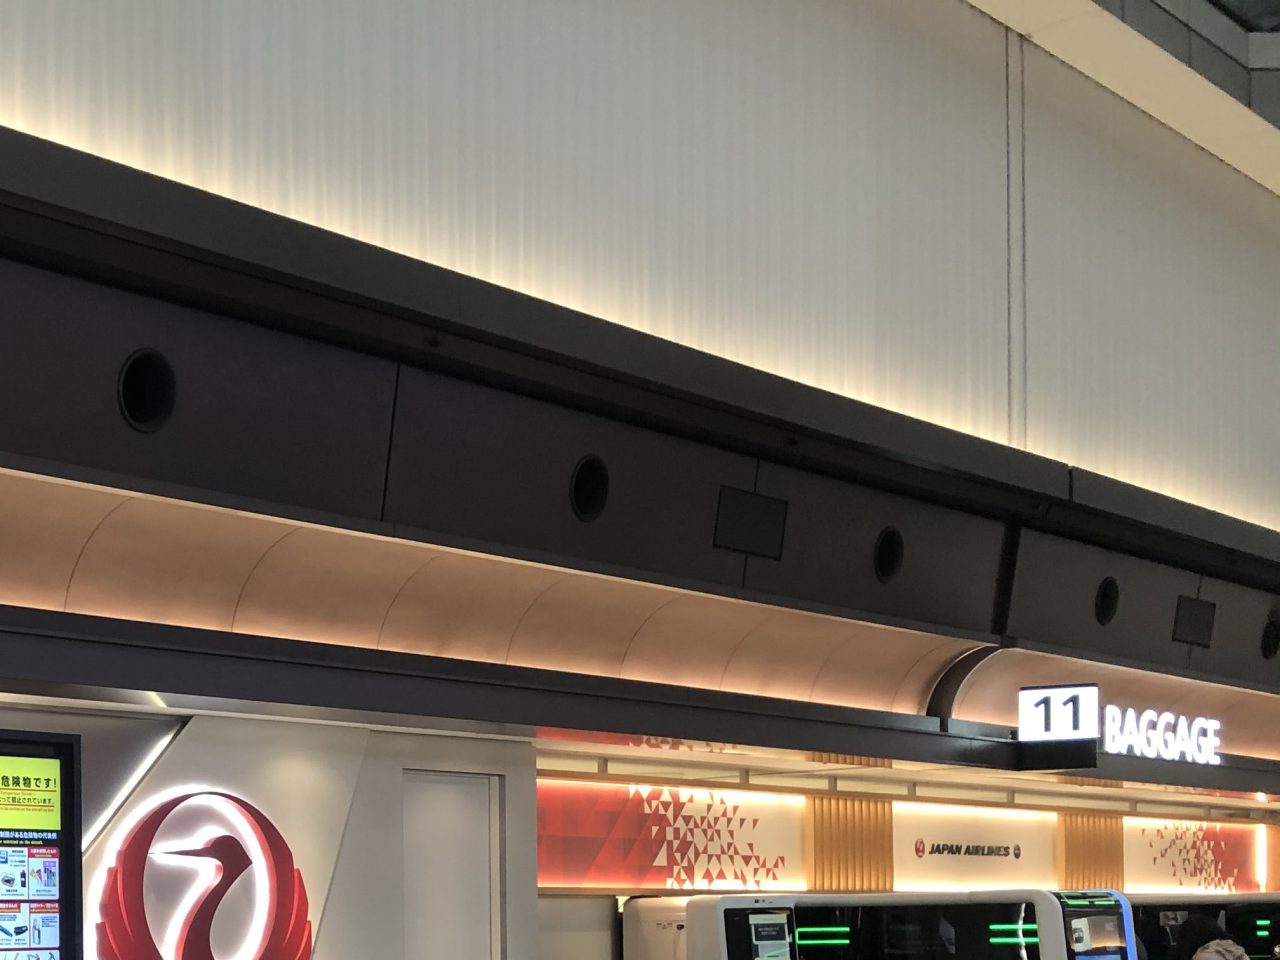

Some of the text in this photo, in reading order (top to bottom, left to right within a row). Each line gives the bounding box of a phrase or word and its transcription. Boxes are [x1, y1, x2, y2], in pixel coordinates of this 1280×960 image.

[1034, 694, 1221, 765] 11 BAGGAGE
[929, 844, 1010, 857] JAPAN AIRLINES
